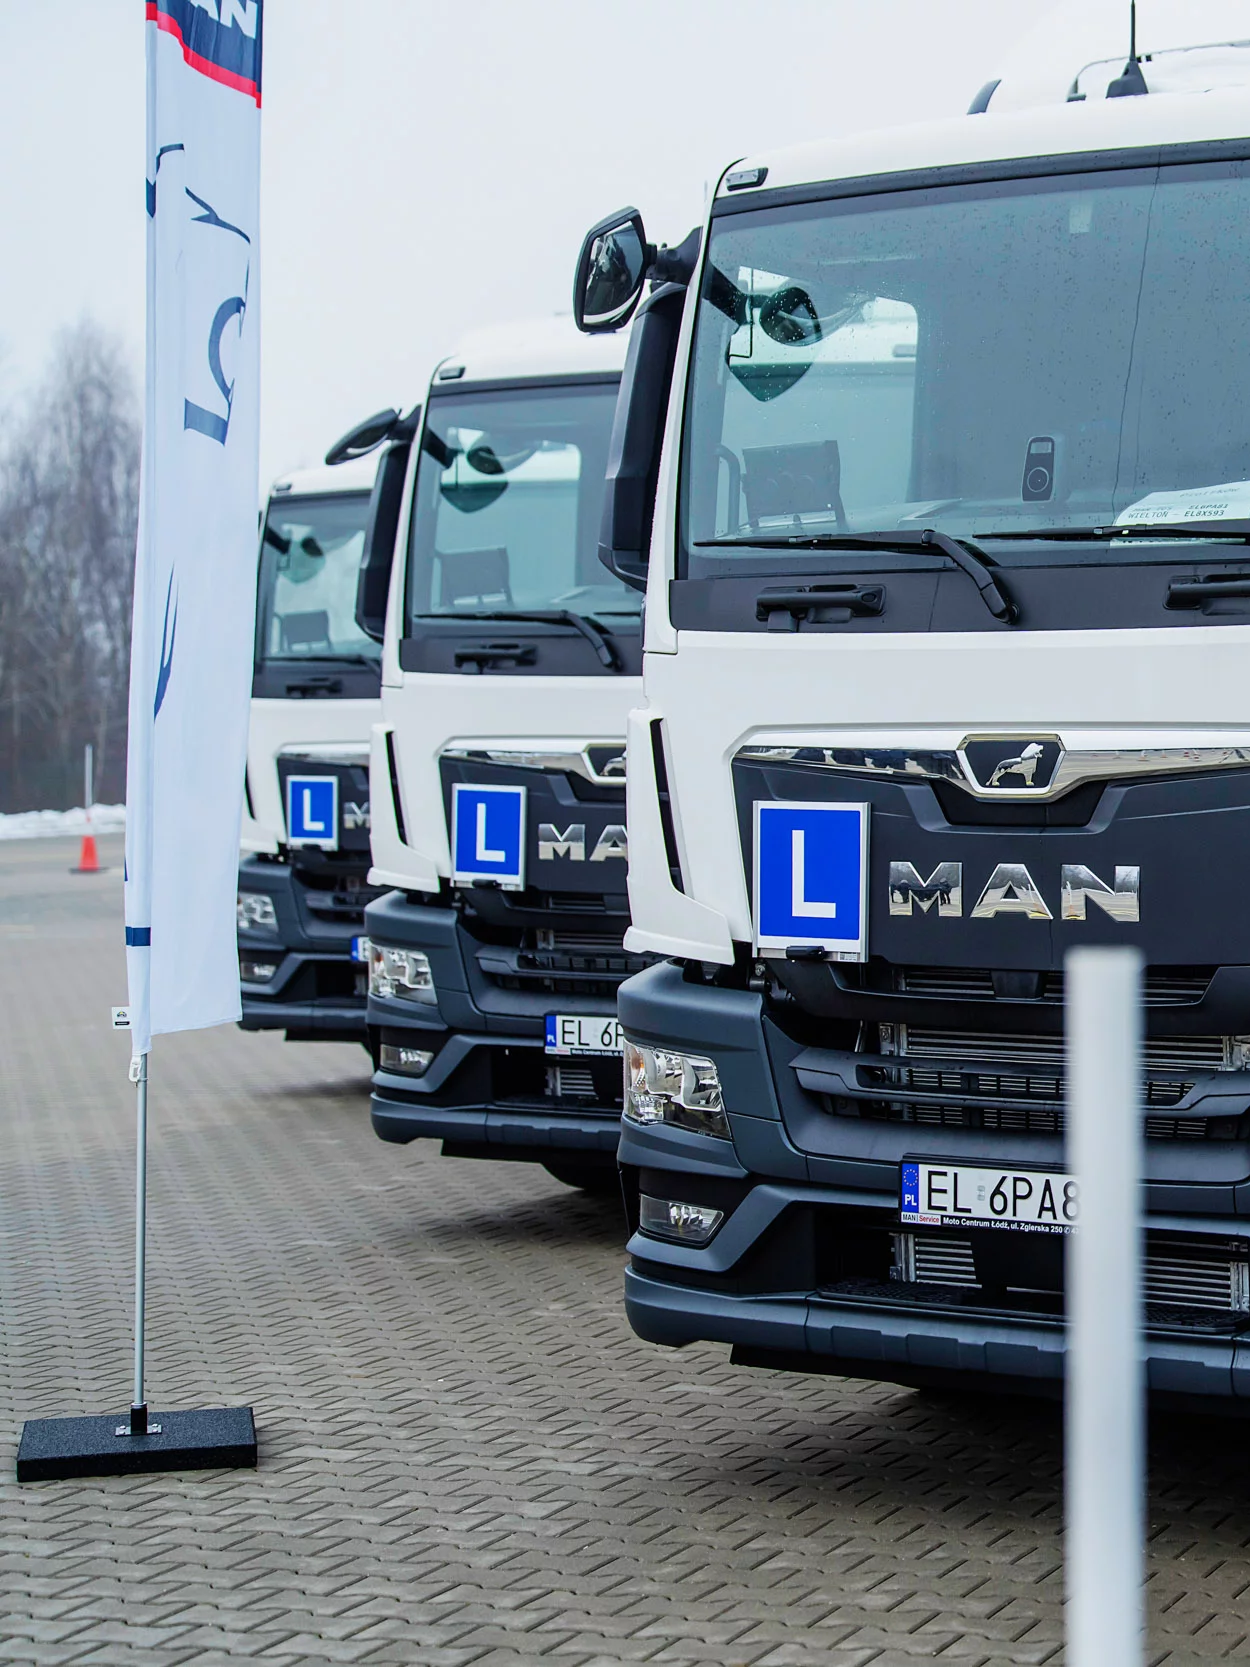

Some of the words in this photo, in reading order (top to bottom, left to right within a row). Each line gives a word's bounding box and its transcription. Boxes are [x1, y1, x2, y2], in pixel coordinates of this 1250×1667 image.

[303, 788, 325, 832] L
[476, 803, 506, 862] L
[792, 829, 836, 919] L
[889, 861, 1141, 922] MAN
[562, 1020, 590, 1046] EL
[905, 1194, 917, 1206] PL
[928, 1170, 972, 1213] EL
[903, 1213, 916, 1221] MAN
[919, 1214, 940, 1223] Service
[943, 1217, 960, 1225] Moto
[961, 1218, 990, 1227] Centrum
